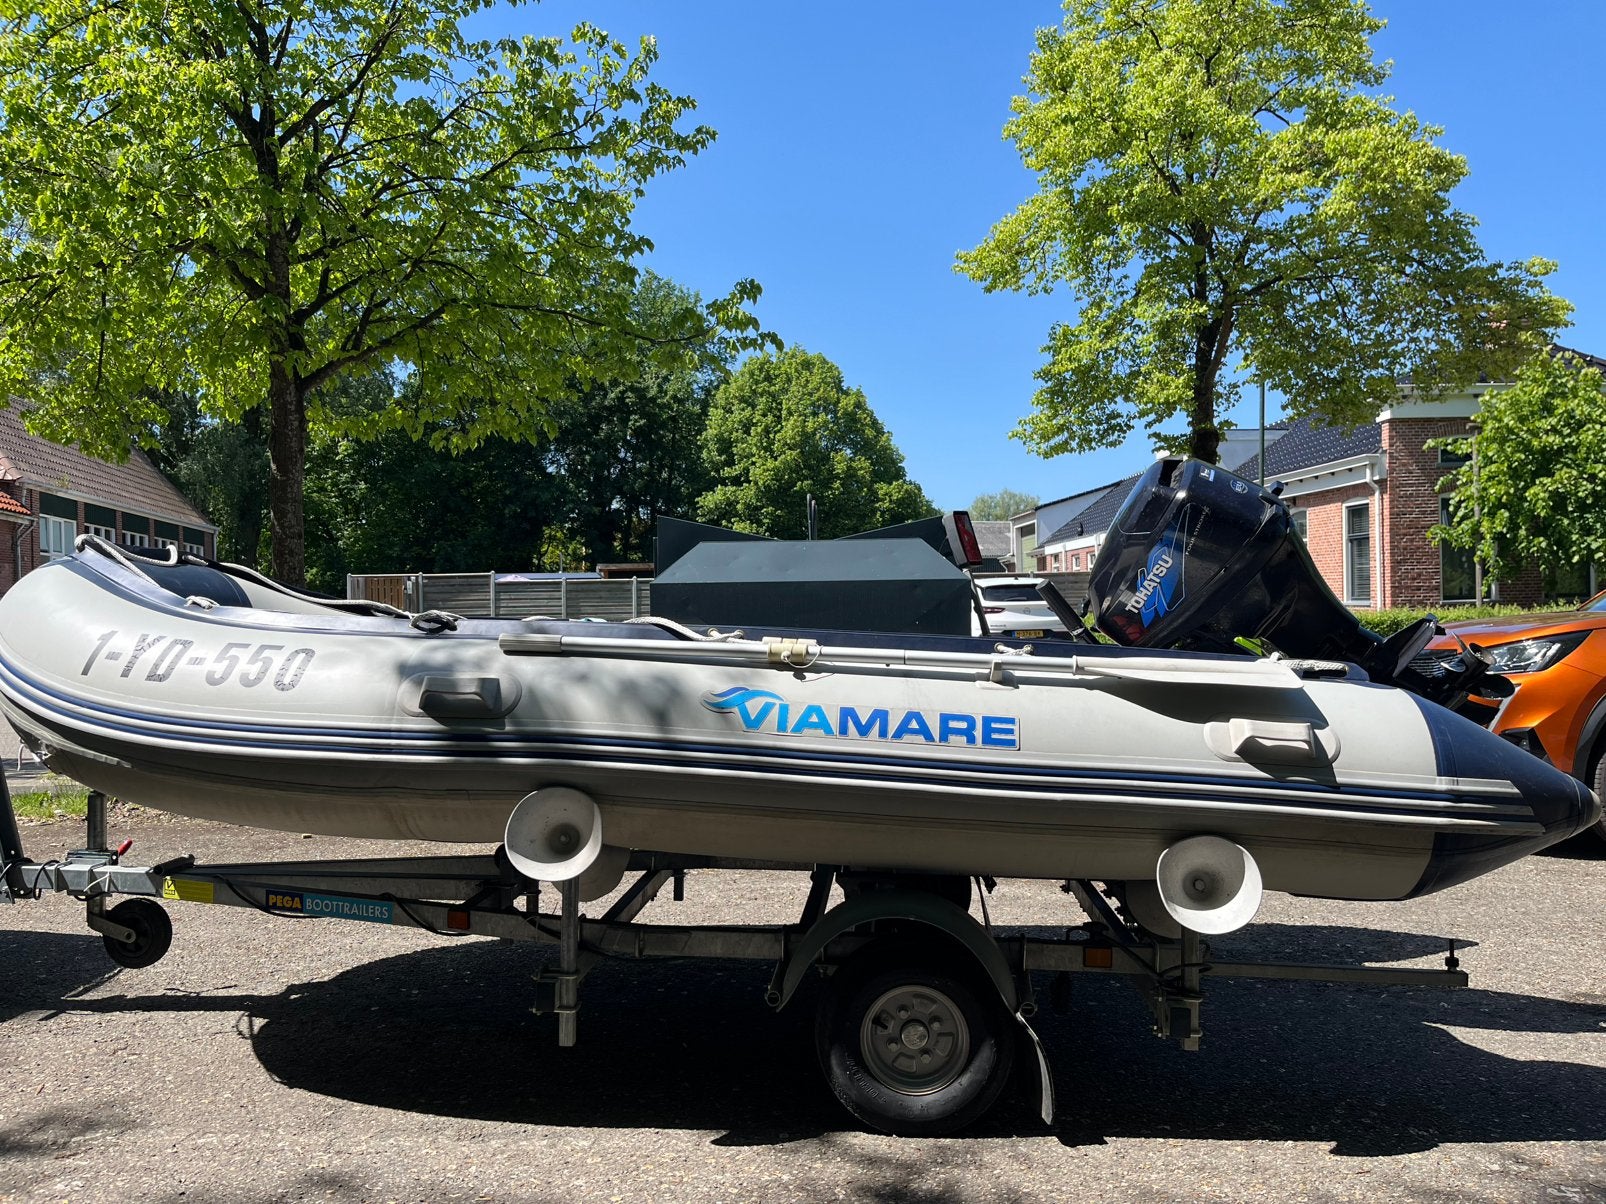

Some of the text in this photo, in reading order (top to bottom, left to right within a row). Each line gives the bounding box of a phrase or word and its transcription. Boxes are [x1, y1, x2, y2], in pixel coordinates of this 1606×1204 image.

[1125, 554, 1173, 614] TOHATSU
[81, 630, 316, 692] 1-YD-550
[735, 699, 1017, 747] VIAMARE
[268, 894, 389, 919] PEGA BOOTTRAILERS
